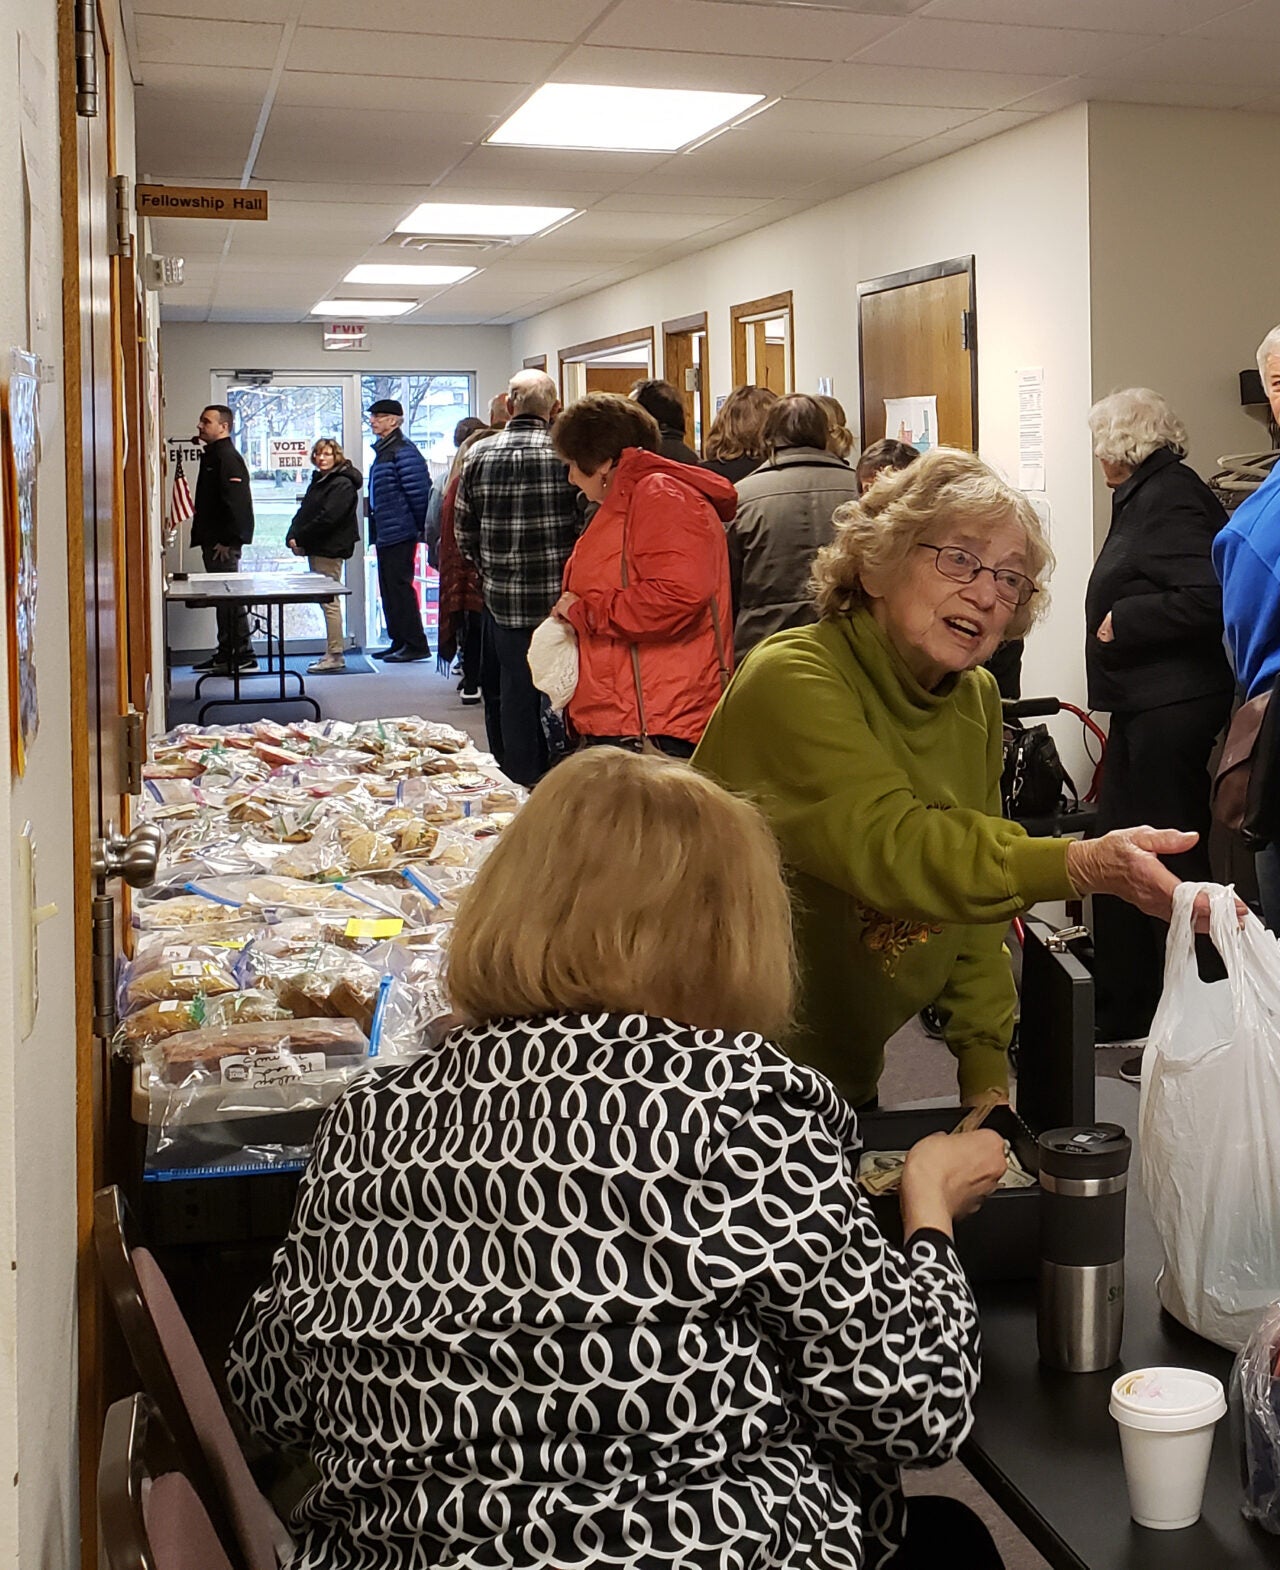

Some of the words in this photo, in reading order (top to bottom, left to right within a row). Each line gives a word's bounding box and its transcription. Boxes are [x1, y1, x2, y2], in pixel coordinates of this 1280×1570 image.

[141, 193, 225, 211] Fellowship
[233, 197, 262, 210] Hall
[274, 441, 305, 451] VOTE
[279, 457, 302, 467] HERE
